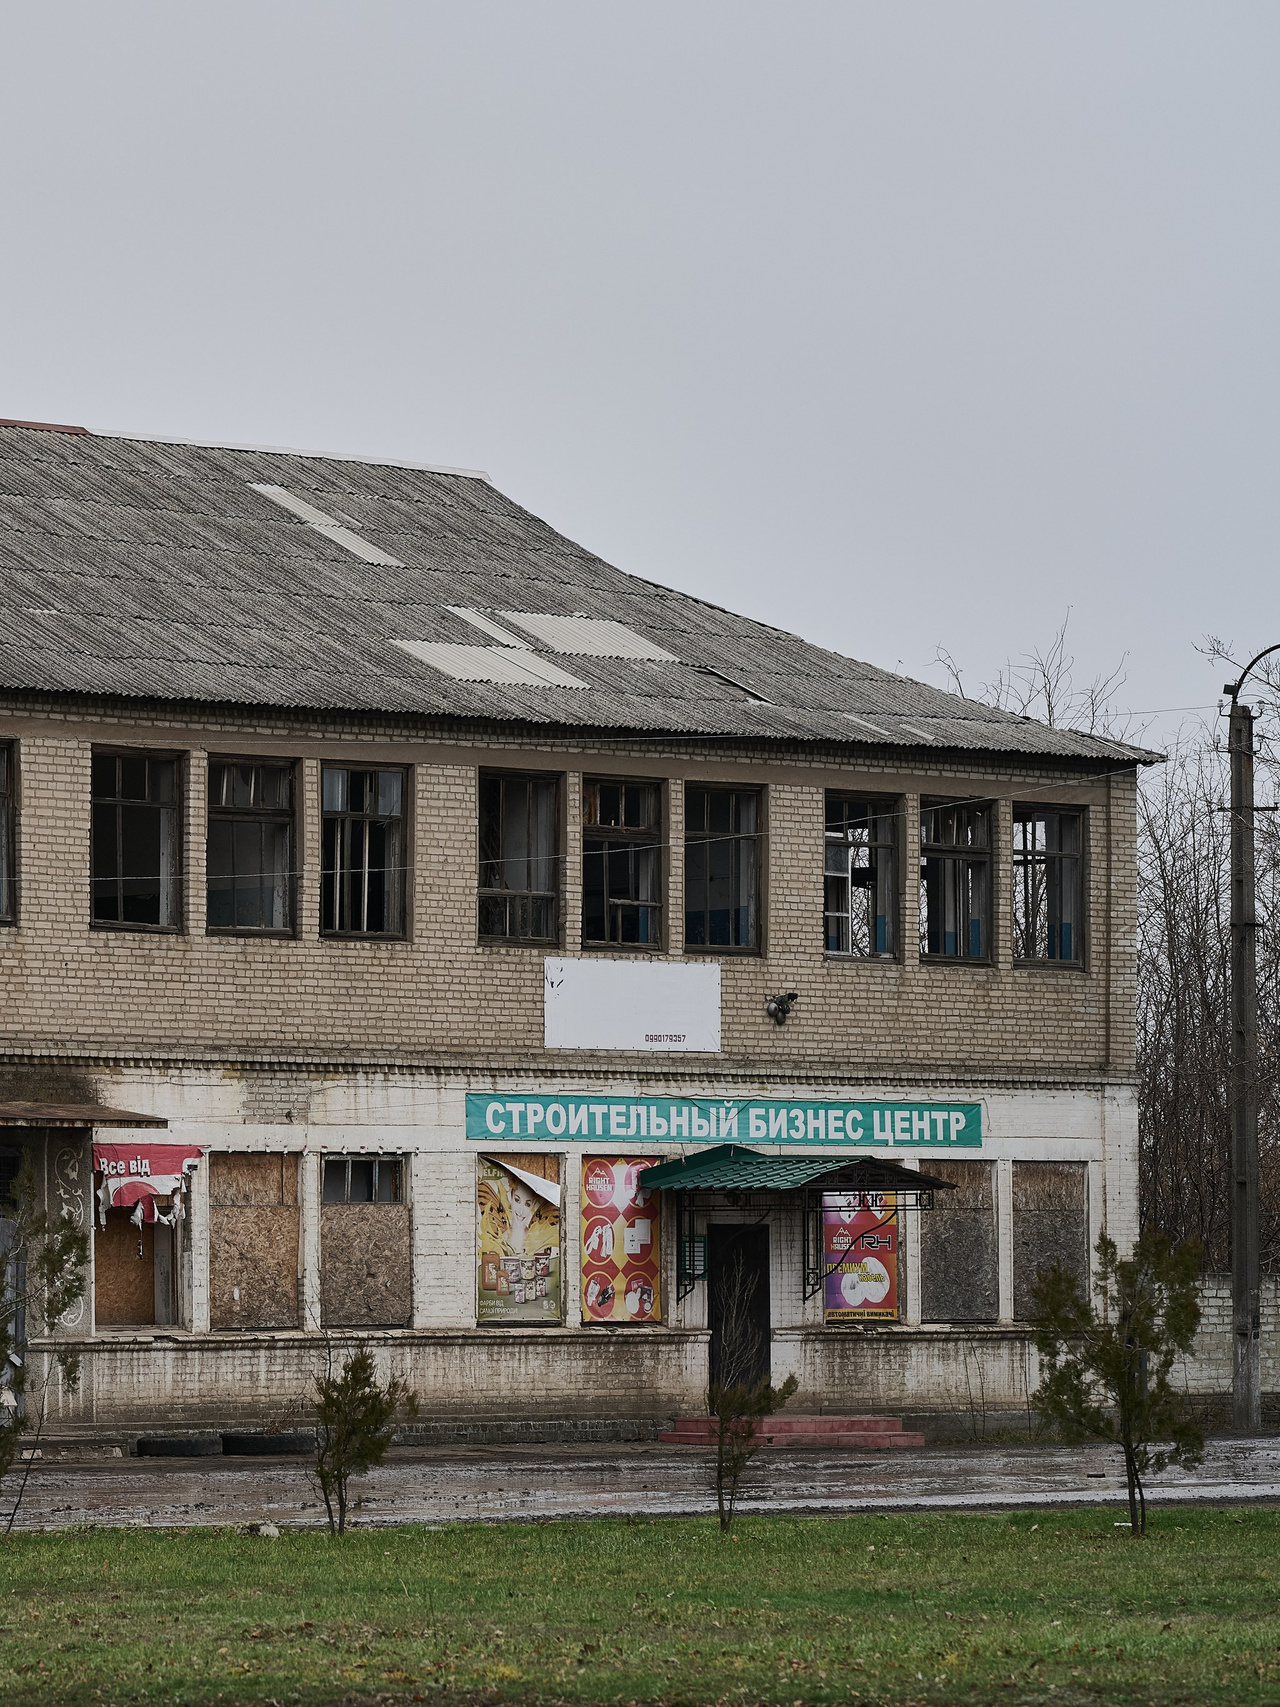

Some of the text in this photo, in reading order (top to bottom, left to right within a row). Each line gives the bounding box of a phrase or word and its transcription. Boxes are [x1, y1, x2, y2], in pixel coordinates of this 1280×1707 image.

[645, 1034, 686, 1042] 0990179357
[486, 1100, 966, 1146] СТРОИТЕЛЬНЫЙ БИЗНЕС ЦЕНТР
[100, 1156, 150, 1177] Все від
[588, 1177, 610, 1185] RIGHT
[586, 1184, 613, 1192] HAUSEN
[833, 1236, 852, 1244] RIGHT
